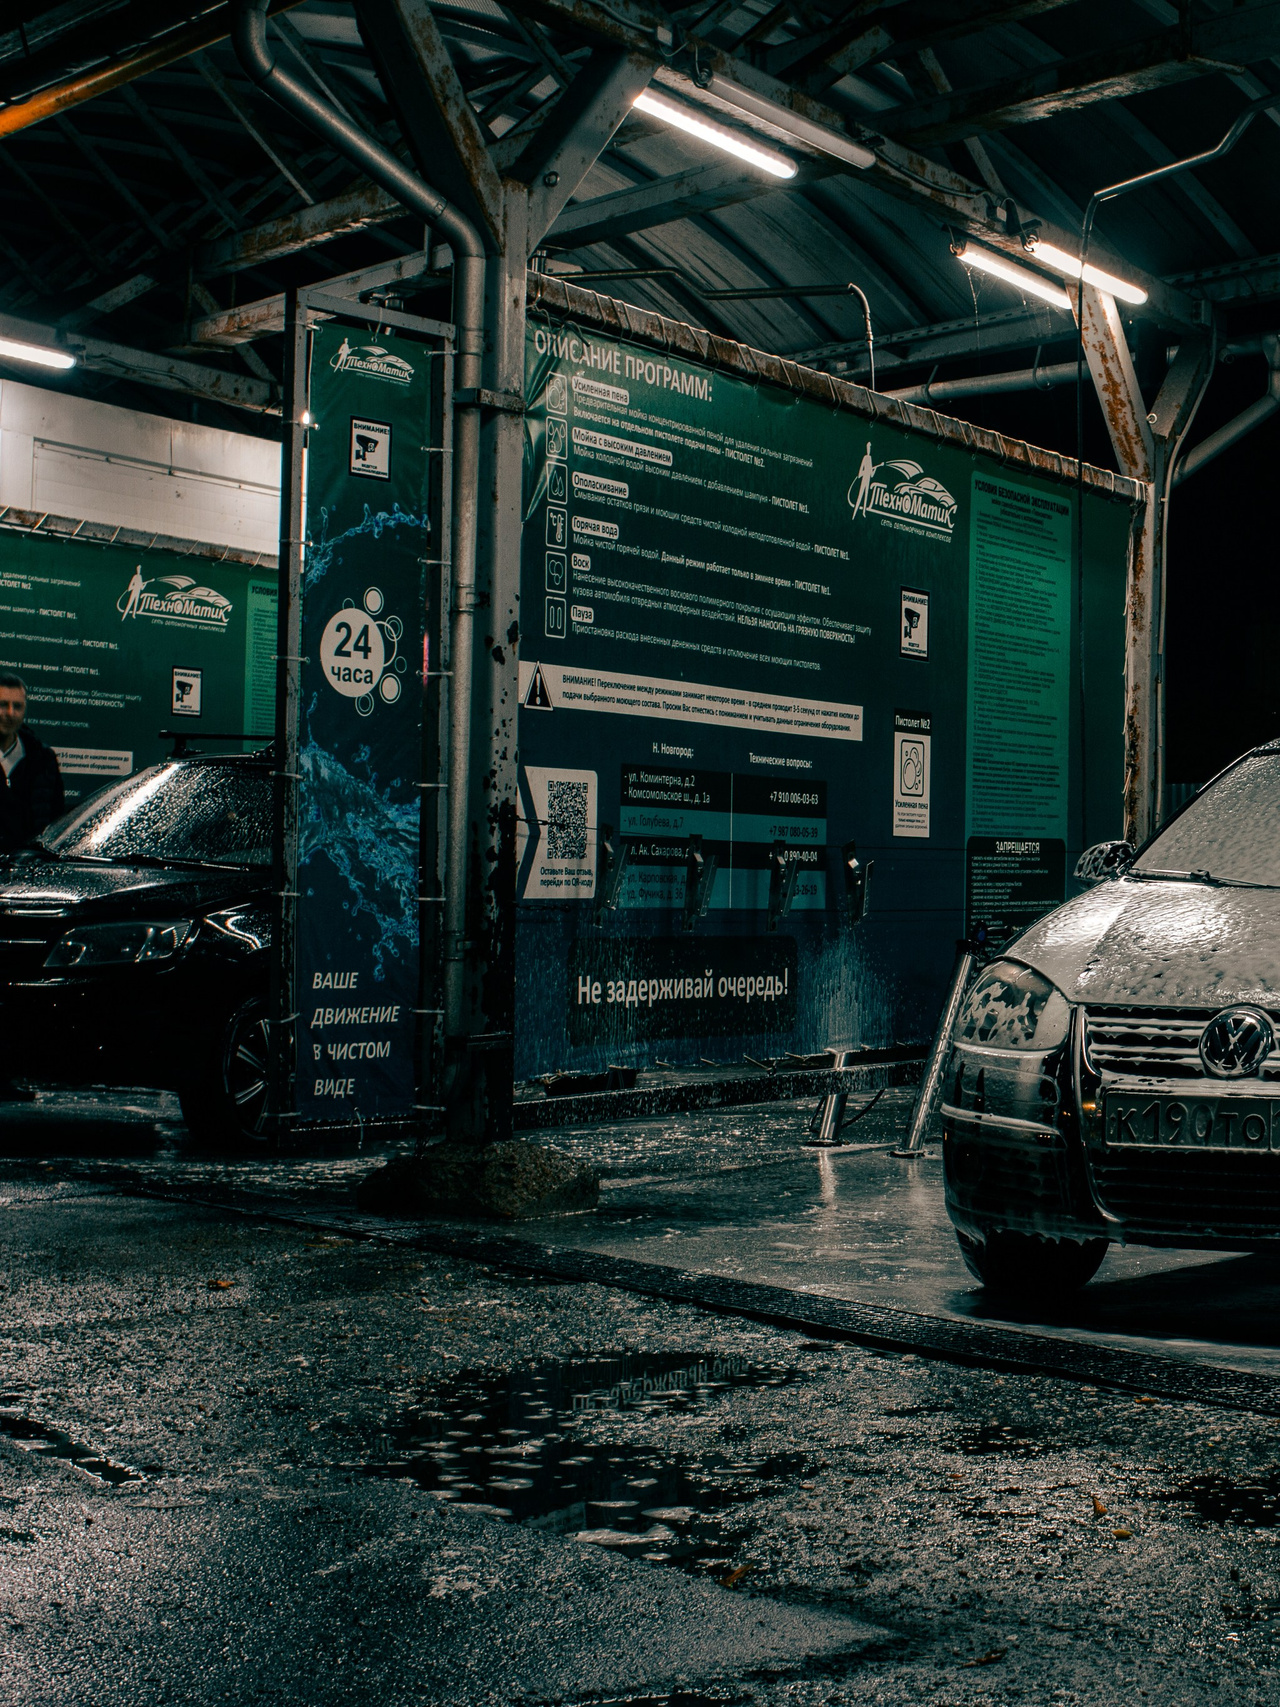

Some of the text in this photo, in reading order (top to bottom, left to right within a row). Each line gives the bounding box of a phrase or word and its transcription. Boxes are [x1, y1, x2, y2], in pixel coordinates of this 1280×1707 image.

[534, 330, 712, 400] ОПИСАНИЕ ПРОГРАММ:
[574, 379, 628, 403] Усиленная пена
[572, 391, 627, 414] Предварительная
[628, 408, 647, 420] мойка
[648, 415, 706, 436] концентрированной
[354, 422, 390, 436] ВНИМАНИЕ!
[572, 406, 765, 467] Включается отдельном пистолете ПИСТОЛЕТ №2.
[573, 428, 670, 462] Мойка высоким давлением
[572, 444, 798, 510] Мойка холодной высоким давлением добавлением ПИСТОЛЕТ
[574, 474, 626, 496] Ополаскивание
[573, 487, 606, 504] Смывание
[606, 497, 632, 510] остатков
[632, 502, 650, 513] грязи
[655, 508, 680, 520] моющих
[680, 514, 702, 526] средств
[721, 524, 747, 536] холодной
[814, 544, 839, 557] ПИСТОЛЕТ
[573, 516, 617, 536] Горячая вода
[880, 518, 892, 528] сеть
[926, 532, 952, 544] комплексов
[572, 533, 820, 593] Мойка чистой горячей Данный режим работает ПИСТОЛЕТ
[573, 555, 590, 568] Воск
[572, 571, 606, 585] Нанесение
[606, 578, 670, 596] высококачественного
[670, 589, 698, 602] воскового
[698, 595, 734, 609] полимерного
[734, 602, 760, 613] покрытия
[572, 606, 592, 620] Пауза
[572, 586, 593, 597] кузова
[594, 590, 630, 602] автомобиля
[662, 602, 700, 615] атмосферных
[736, 614, 757, 626] НЕЛЬЗЯ
[758, 618, 786, 632] НАНОСИТЬ
[795, 625, 818, 637] ГРЯЗНУЮ
[819, 629, 855, 643] ПОВЕРХНОСТЬ!
[334, 620, 372, 660] 24
[571, 621, 614, 637] Приостановка
[614, 630, 638, 641] расхода
[639, 634, 670, 645] внесенных
[671, 639, 700, 650] денежных
[700, 644, 722, 654] средств
[726, 648, 758, 660] отключение
[330, 664, 374, 686] часа
[562, 674, 730, 704] ВНИМАНИЕ! Переключение между режимами занимает некоторое
[562, 691, 582, 700] подачи
[584, 692, 615, 703] выбранного
[616, 697, 640, 706] моющего
[692, 706, 714, 715] отнестись
[719, 710, 748, 719] пониманием
[752, 714, 775, 723] учитывать
[895, 714, 930, 730] Пистолет №2
[660, 743, 694, 758] Новгород:
[748, 752, 812, 769] Технические вопросы:
[628, 771, 695, 787] ул. Коминтерна, д.2
[628, 786, 682, 801] Комсомольское
[778, 791, 790, 803] 910
[790, 792, 819, 804] 006-03-63
[894, 799, 928, 810] Усиленная пена
[638, 814, 671, 828] Голубева,
[638, 843, 682, 856] Ак. Сахарова,
[995, 840, 1040, 855] ЗАПРЕЩАЕТСЯ
[540, 866, 592, 876] Оставьте отзыв,
[540, 877, 562, 887] перейди
[570, 877, 592, 887] QR-коду
[312, 971, 360, 990] ВАШЕ
[577, 966, 789, 1009] Не задерживай очередь!
[310, 1005, 400, 1030] ДВИЖЕНИЕ
[313, 1041, 391, 1060] В ЧИСТОМ
[314, 1078, 356, 1099] ВИДЕ
